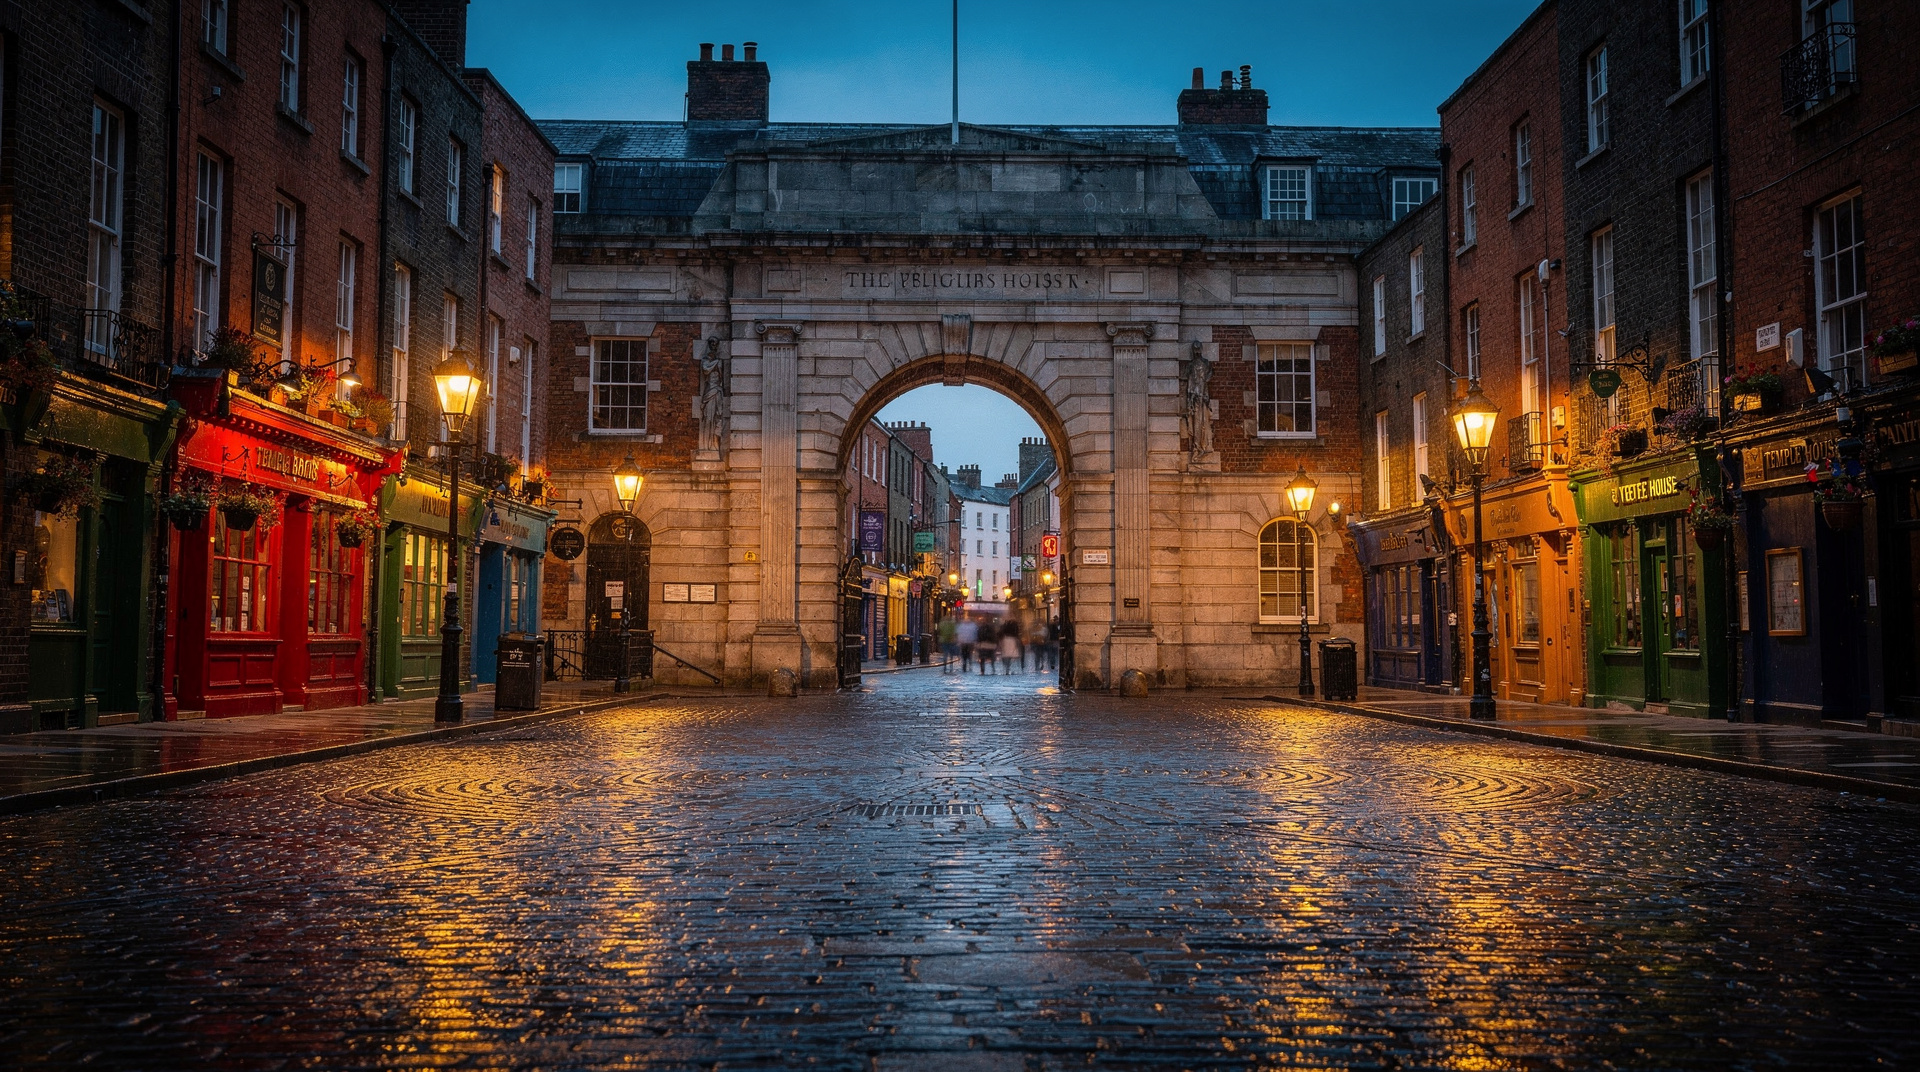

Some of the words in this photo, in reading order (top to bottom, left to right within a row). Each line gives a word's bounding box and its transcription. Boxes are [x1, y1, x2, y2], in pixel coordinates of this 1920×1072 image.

[846, 272, 891, 288] THE
[1763, 445, 1802, 469] TEMPLE
[1649, 475, 1678, 498] HOUSE
